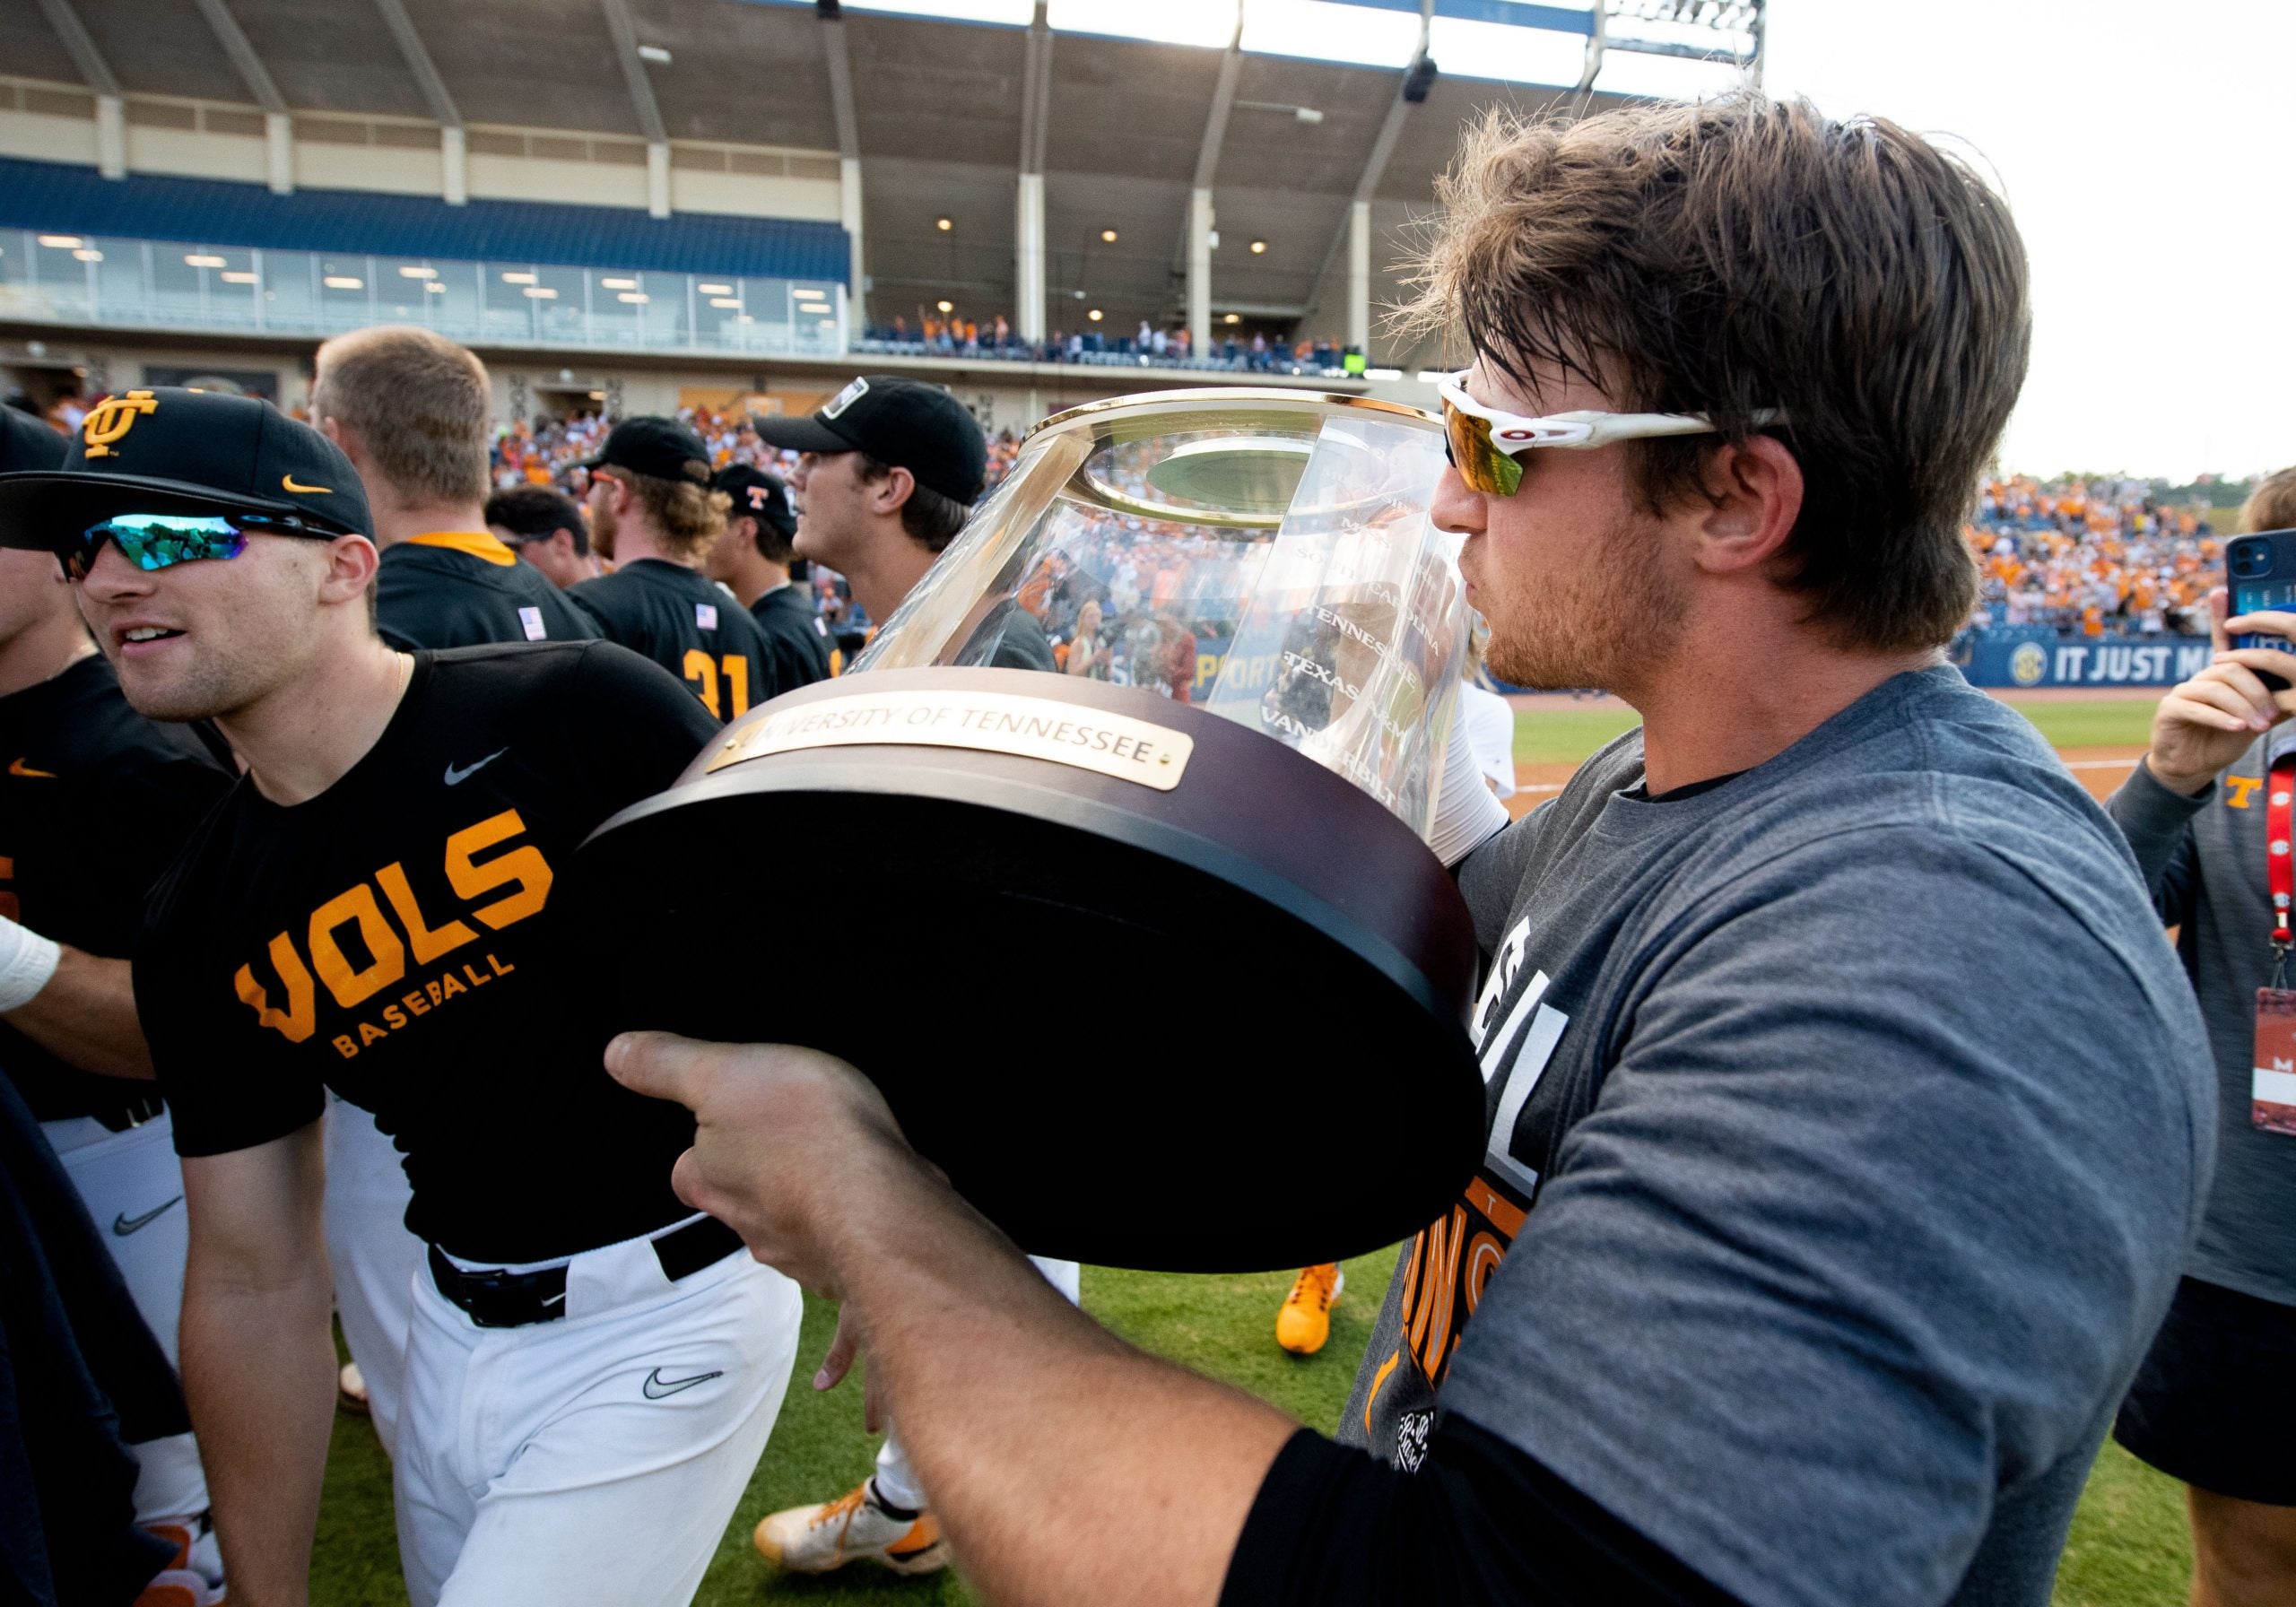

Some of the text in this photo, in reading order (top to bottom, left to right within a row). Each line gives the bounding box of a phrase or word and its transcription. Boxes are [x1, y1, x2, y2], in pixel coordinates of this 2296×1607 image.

[746, 485, 770, 509] T
[1306, 604, 1417, 689] TENNESSEE
[2054, 646, 2089, 682] IT
[2087, 646, 2171, 682] JUST
[2176, 646, 2213, 680] M
[1283, 650, 1361, 701] TEXAS
[907, 706, 951, 725] OF
[962, 708, 1154, 763] TENNESSEE
[1261, 705, 1396, 806] VANRBILT
[2225, 774, 2264, 809] T
[234, 808, 554, 1043] VOLS
[332, 953, 516, 1059] BASEBALL
